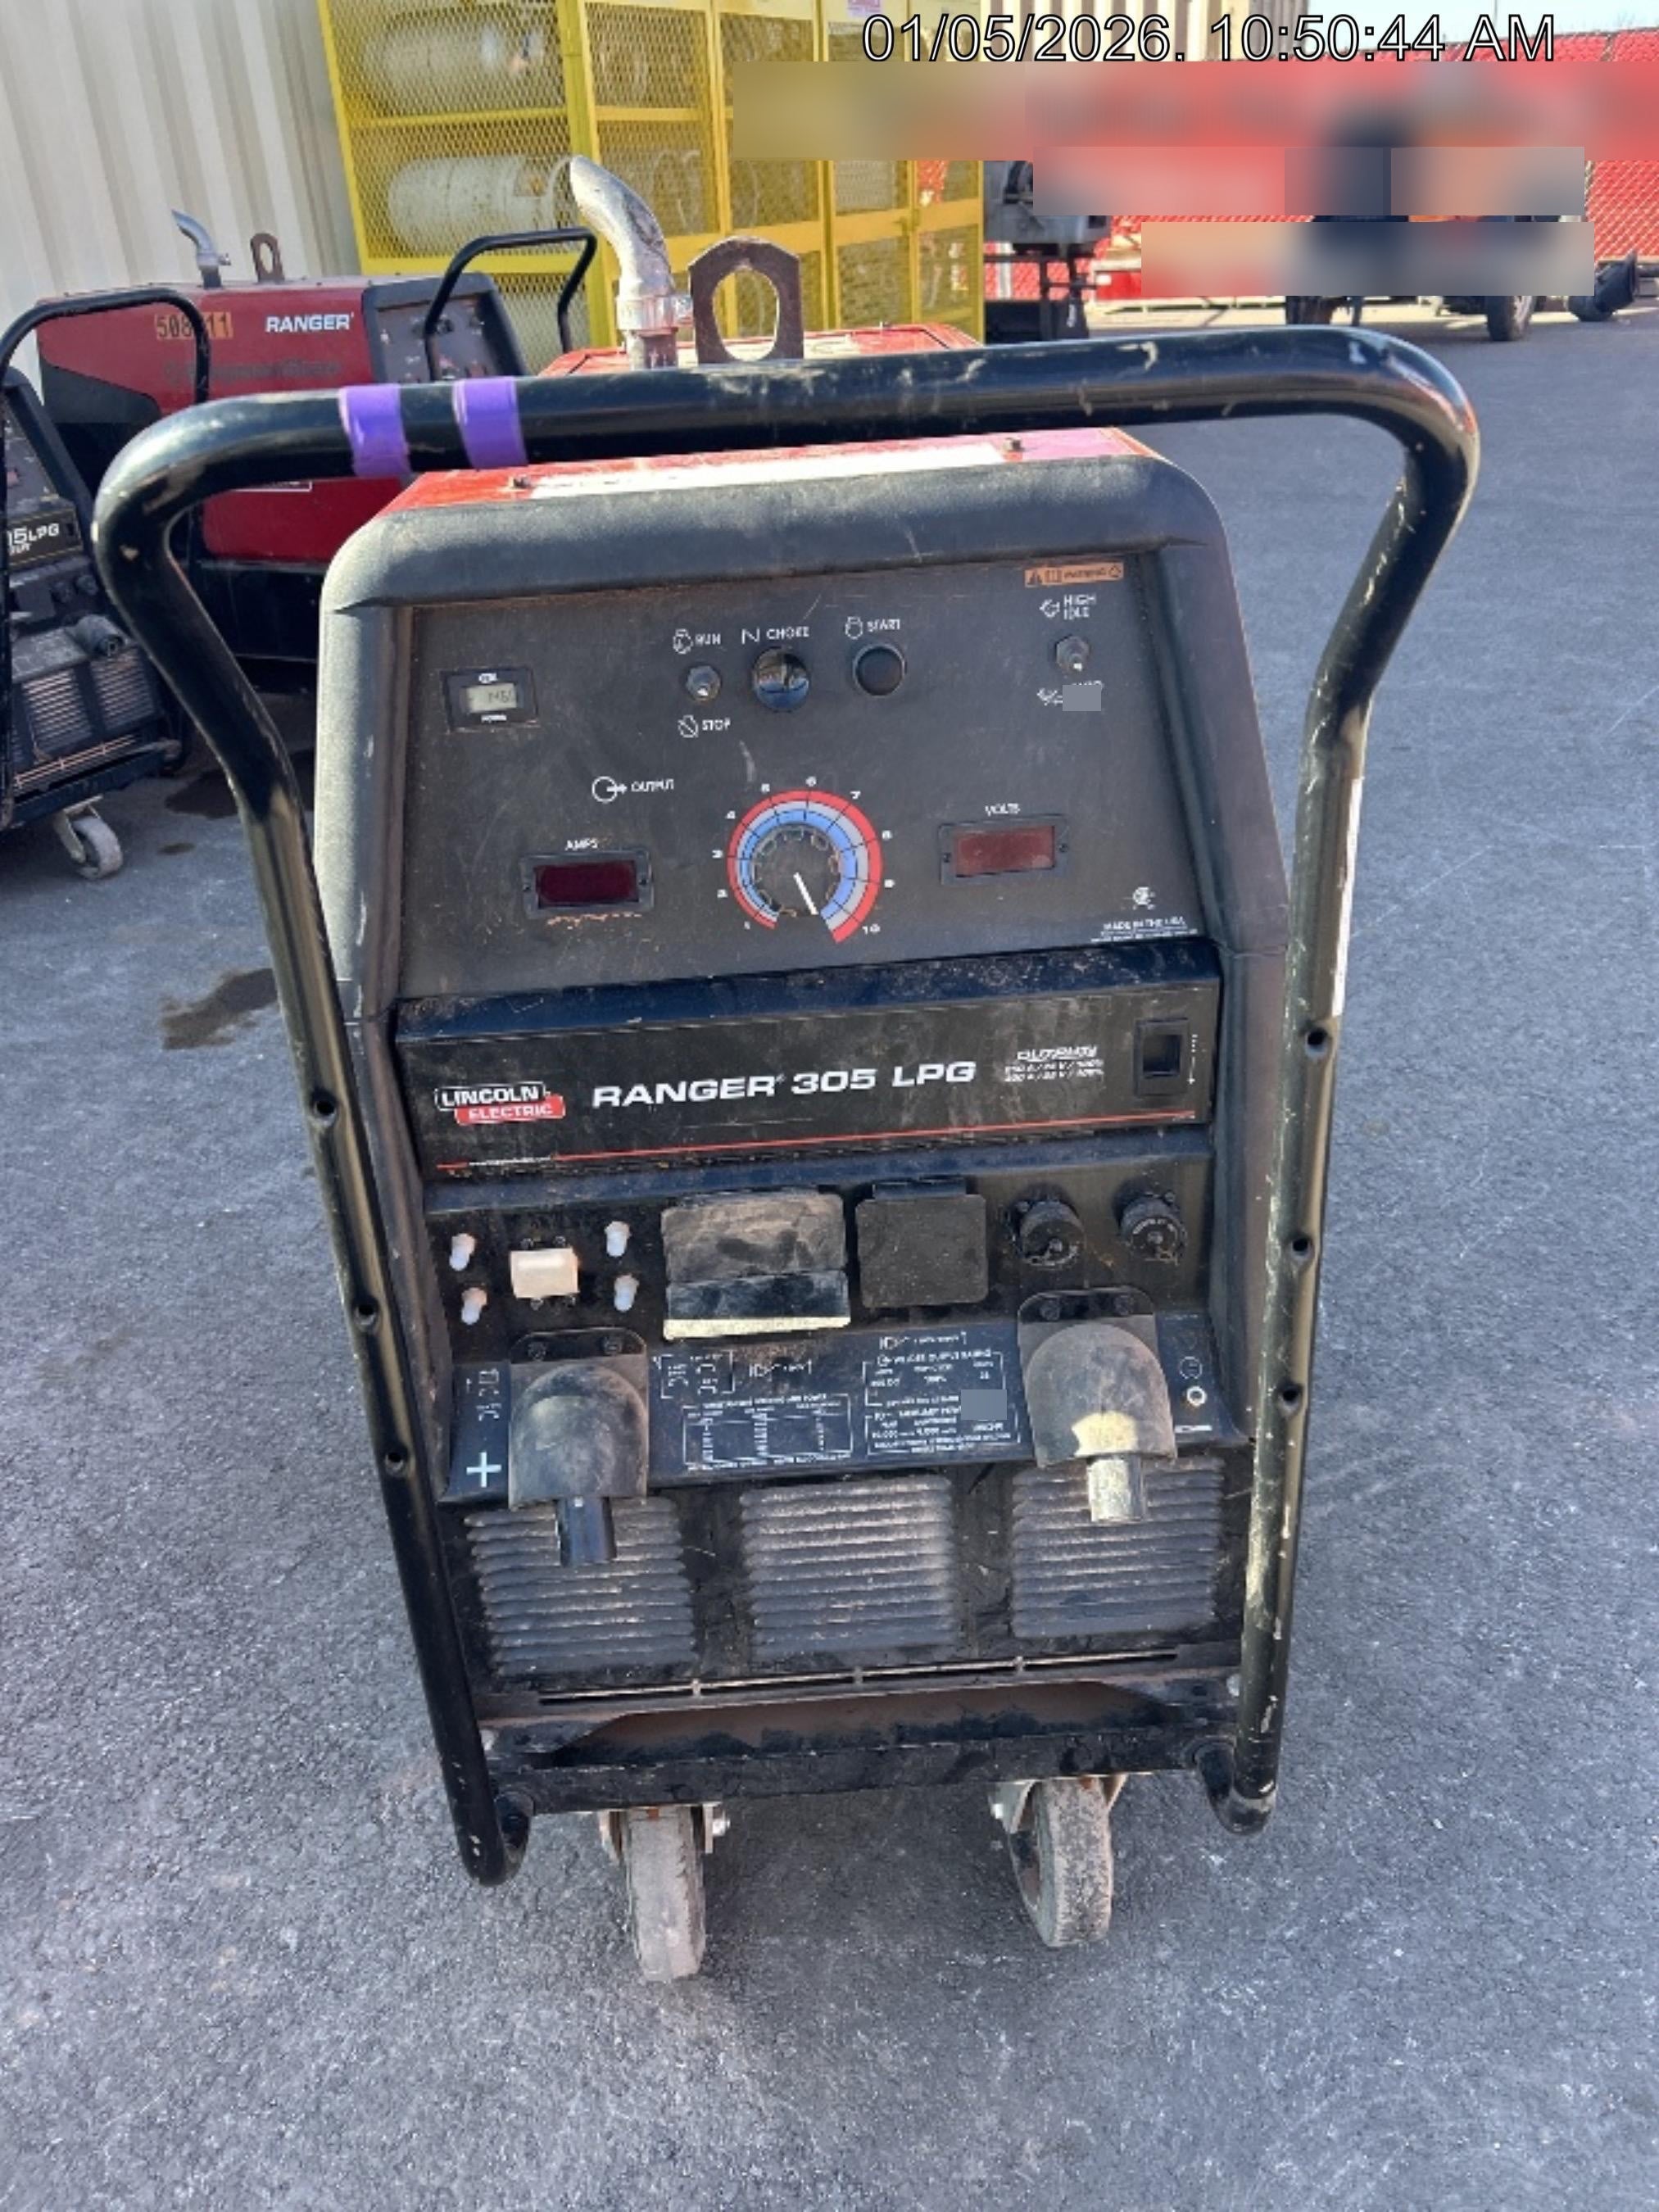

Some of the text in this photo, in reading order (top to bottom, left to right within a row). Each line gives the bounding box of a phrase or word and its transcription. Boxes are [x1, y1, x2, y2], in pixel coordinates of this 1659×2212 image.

[156, 314, 229, 338] 50811
[265, 314, 350, 333] RANGER
[766, 626, 810, 641] CHOKE
[592, 1076, 777, 1109] RANGER
[791, 1068, 878, 1095] 305
[891, 1061, 977, 1088] LPG
[441, 1086, 539, 1107] LINCOLN
[468, 1103, 554, 1120] ELECTRIC
